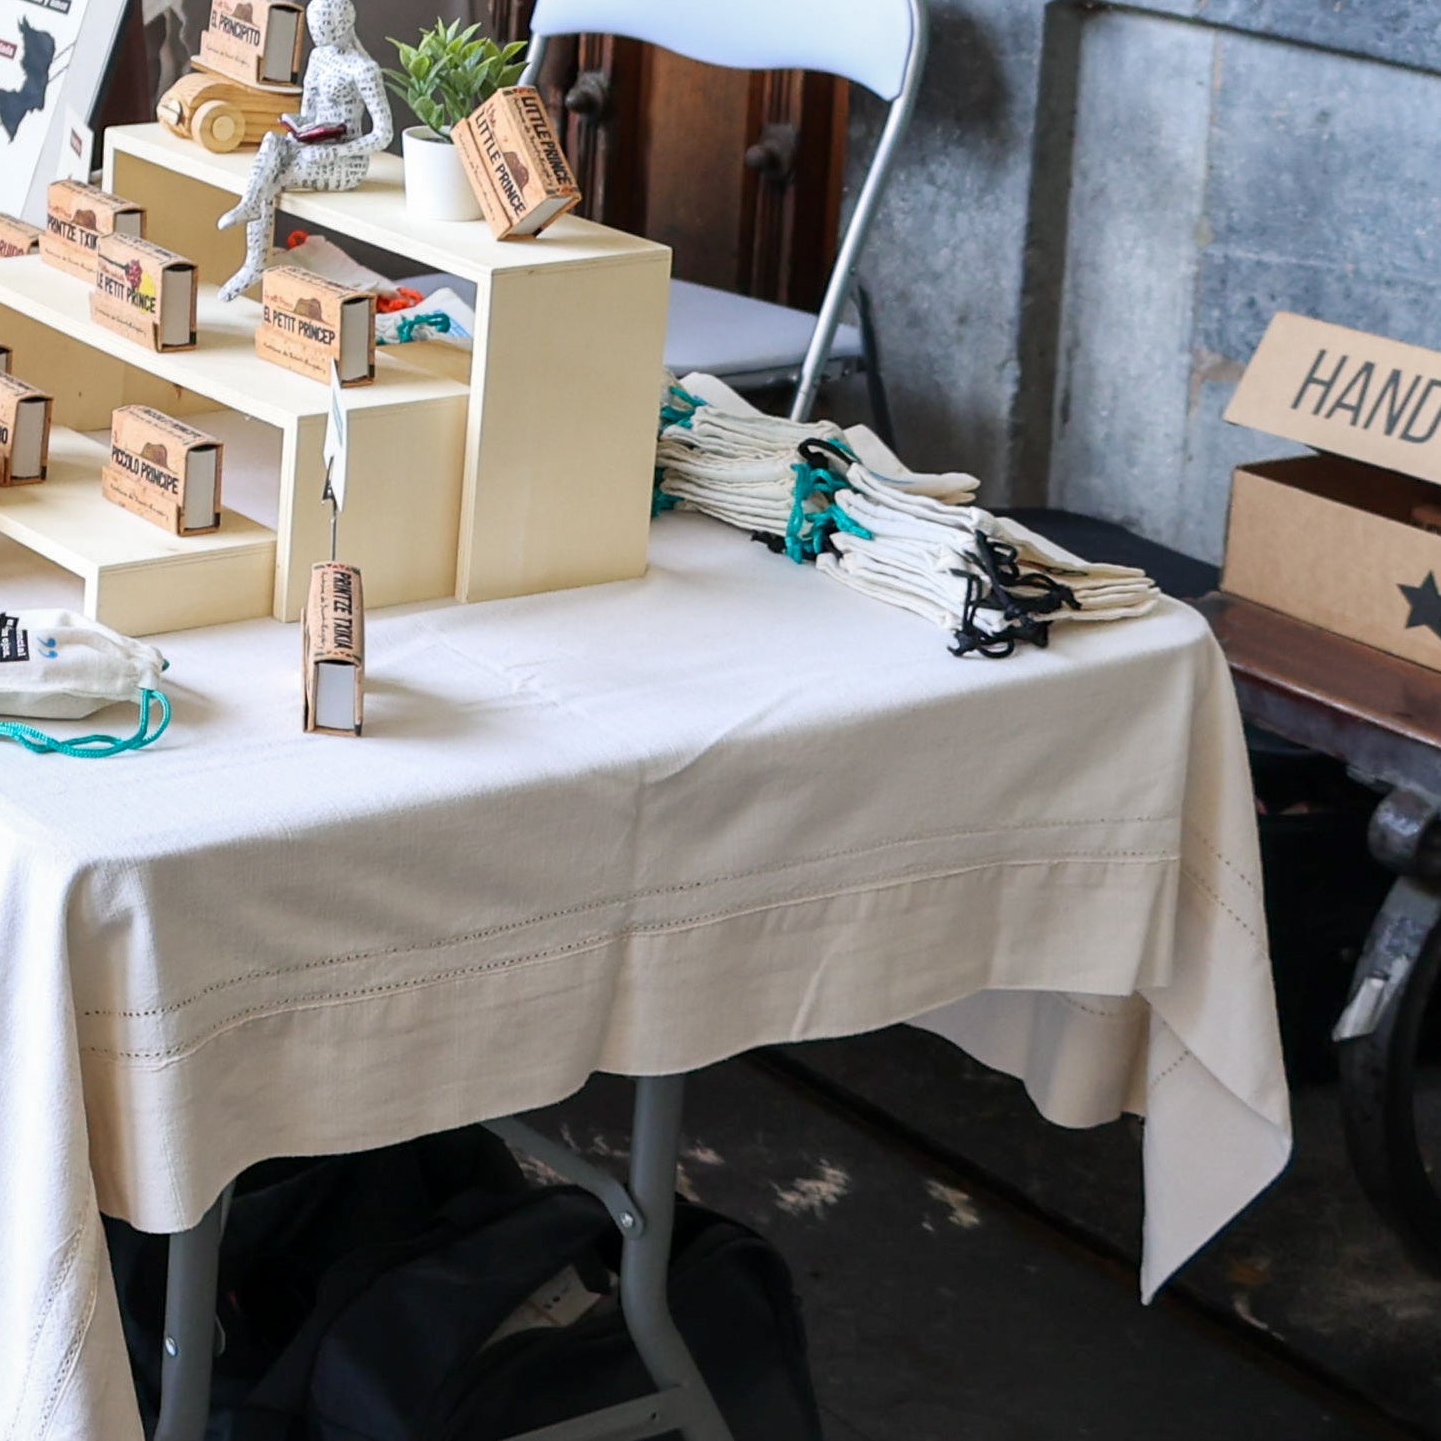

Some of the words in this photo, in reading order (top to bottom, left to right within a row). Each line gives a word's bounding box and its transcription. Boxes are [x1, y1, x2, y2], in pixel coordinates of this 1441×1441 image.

[218, 14, 262, 47] PRINCIPITO
[522, 95, 551, 139] LITTLE
[543, 135, 572, 186] PRINCE
[475, 109, 501, 166] LITTLE
[494, 161, 527, 217] PRINCE
[47, 213, 77, 244] PRINTZE
[96, 271, 104, 291] LE
[104, 275, 126, 301] PETIT
[126, 286, 156, 315] PRINCE
[263, 305, 272, 323] EL
[273, 309, 296, 334] PETIT
[1290, 348, 1441, 444] HAND
[112, 445, 139, 475] PICCOLO
[141, 461, 180, 495] PRINCIPE
[333, 570, 353, 614] PRINTZE
[333, 615, 354, 651] TXIKIA
